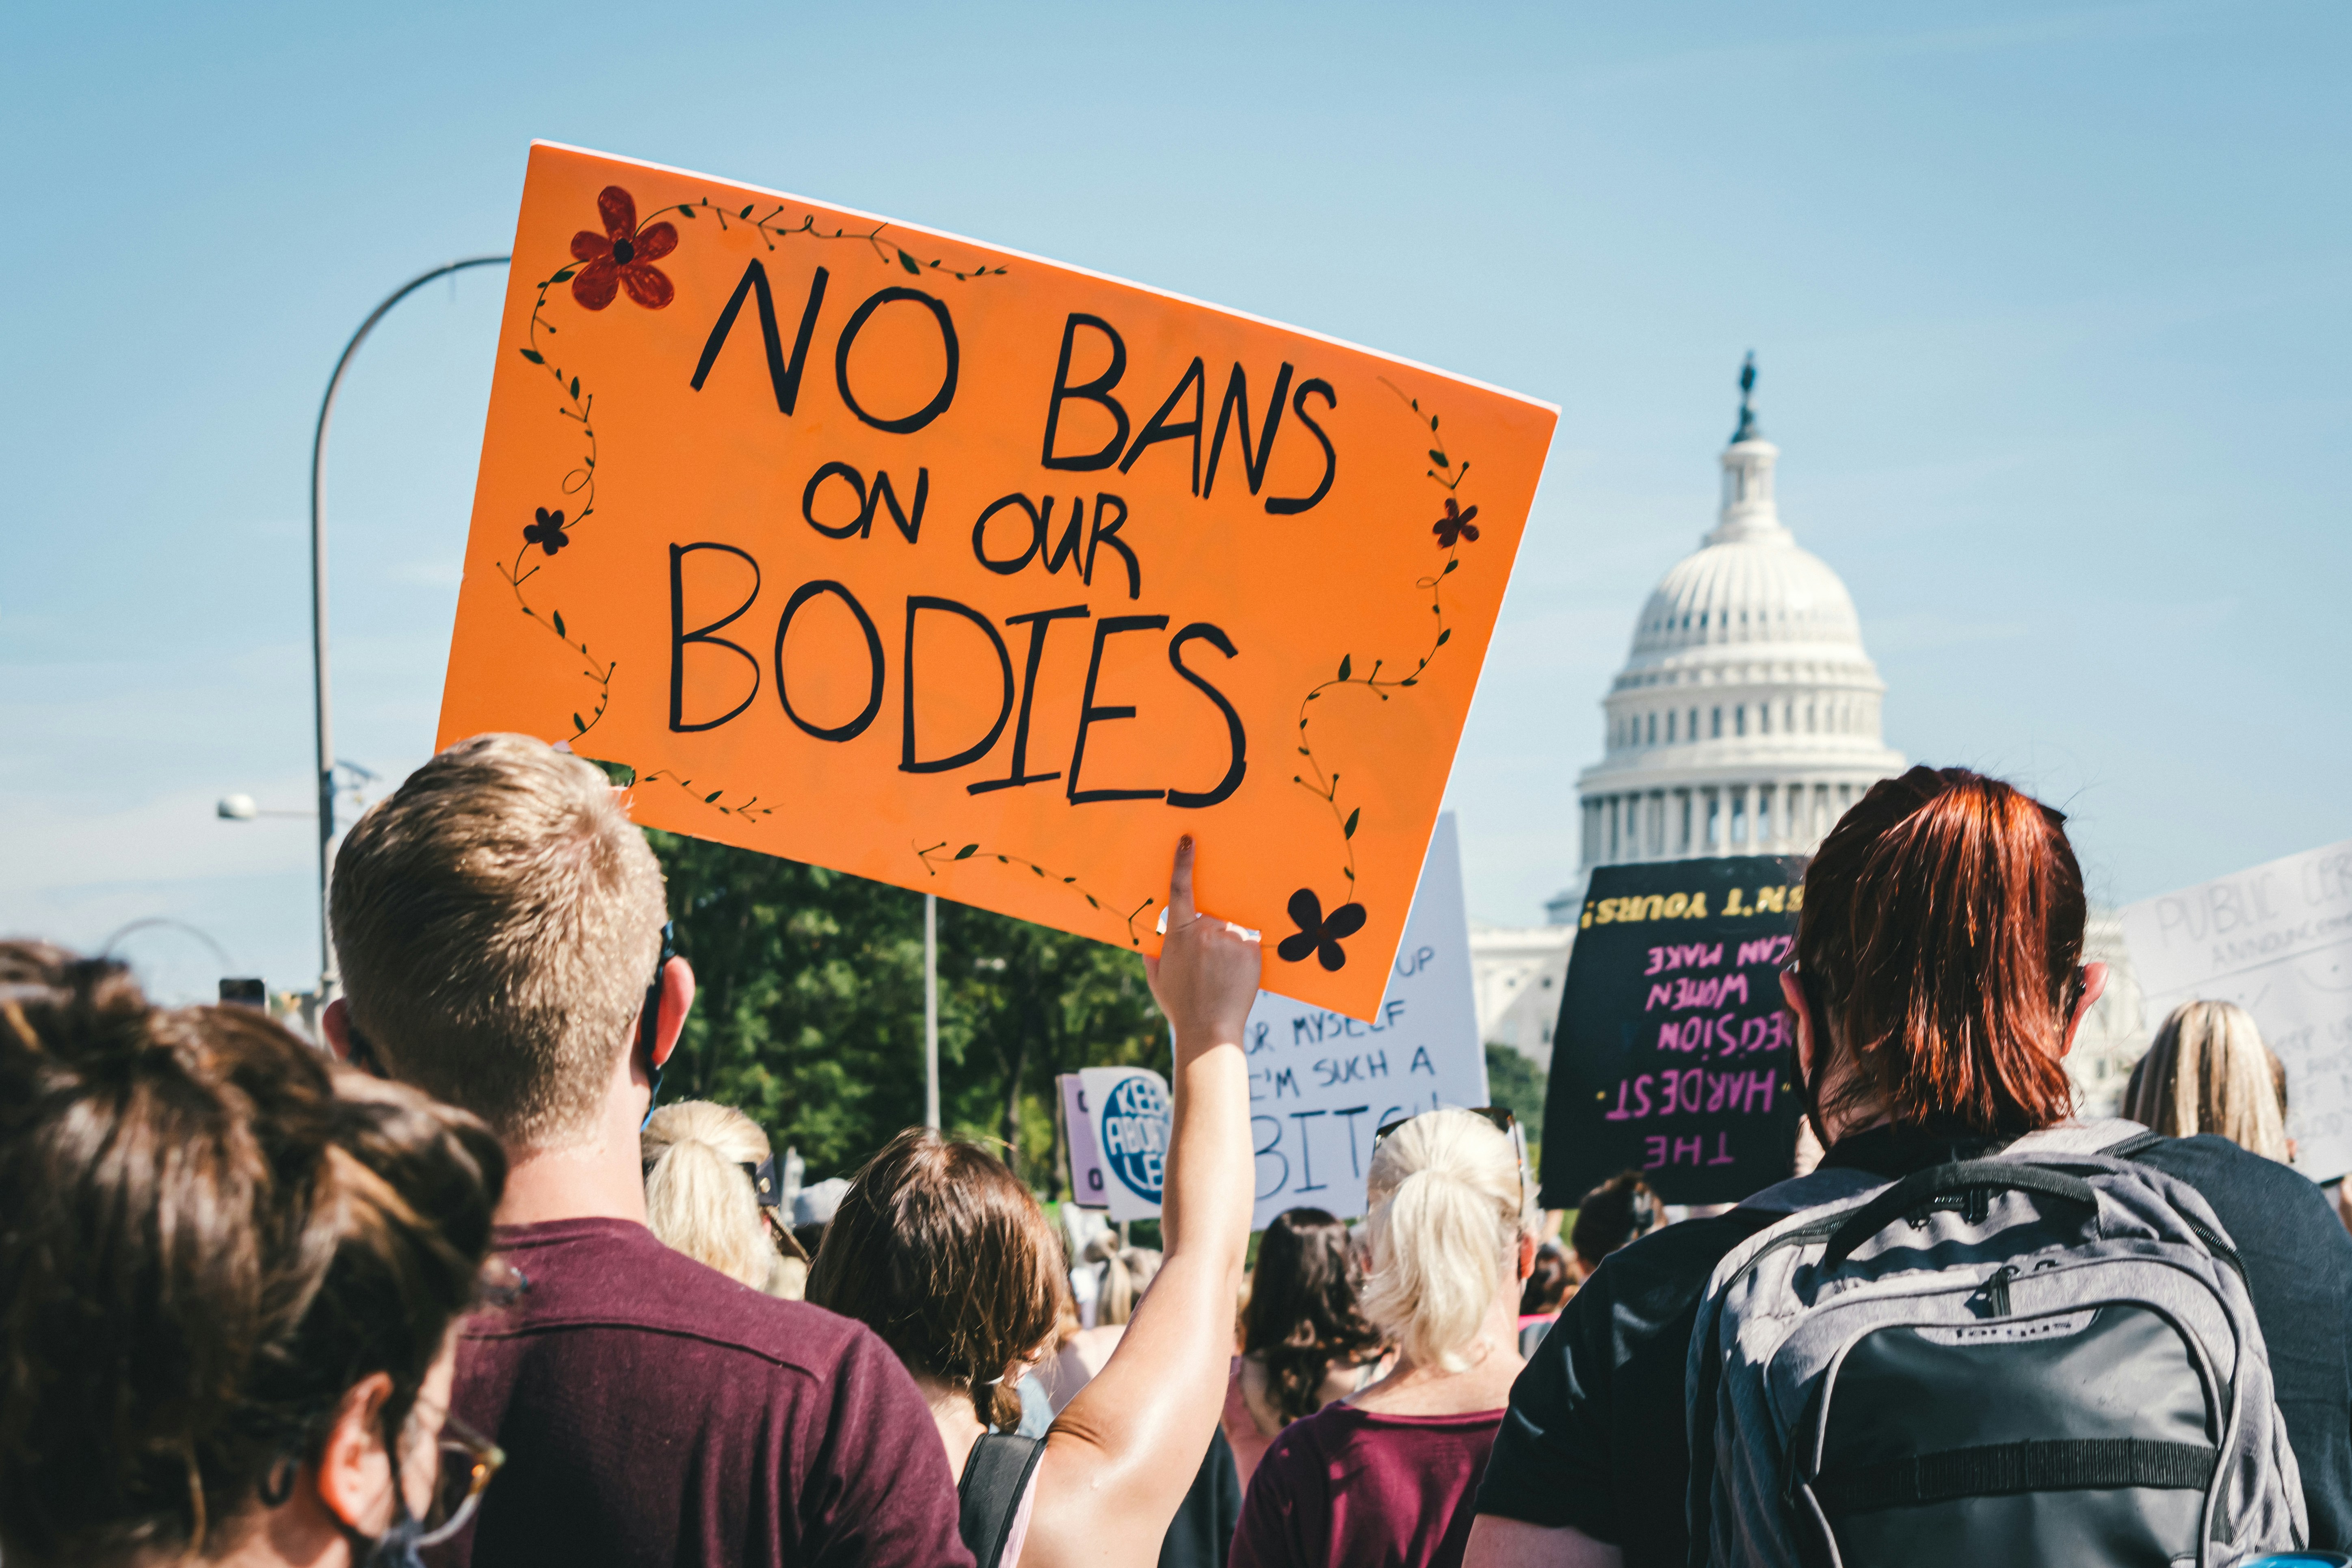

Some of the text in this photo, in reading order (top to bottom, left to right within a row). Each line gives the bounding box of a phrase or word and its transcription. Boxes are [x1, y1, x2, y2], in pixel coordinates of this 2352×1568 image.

[690, 258, 1337, 515] NO BANS
[802, 461, 1140, 600] ON OUR
[669, 542, 1246, 809] BODIES
[1581, 892, 1707, 929] YOURS!
[1395, 945, 1435, 977] UP
[1644, 935, 1795, 975] CAN MAKE
[1645, 972, 1748, 1011] WOMEN
[1312, 1049, 1389, 1088] SUCH
[1410, 1045, 1436, 1077] A
[1606, 1068, 1775, 1120] HARDEST
[1251, 1091, 1438, 1201] BIT
[1644, 1133, 1734, 1169] THE
